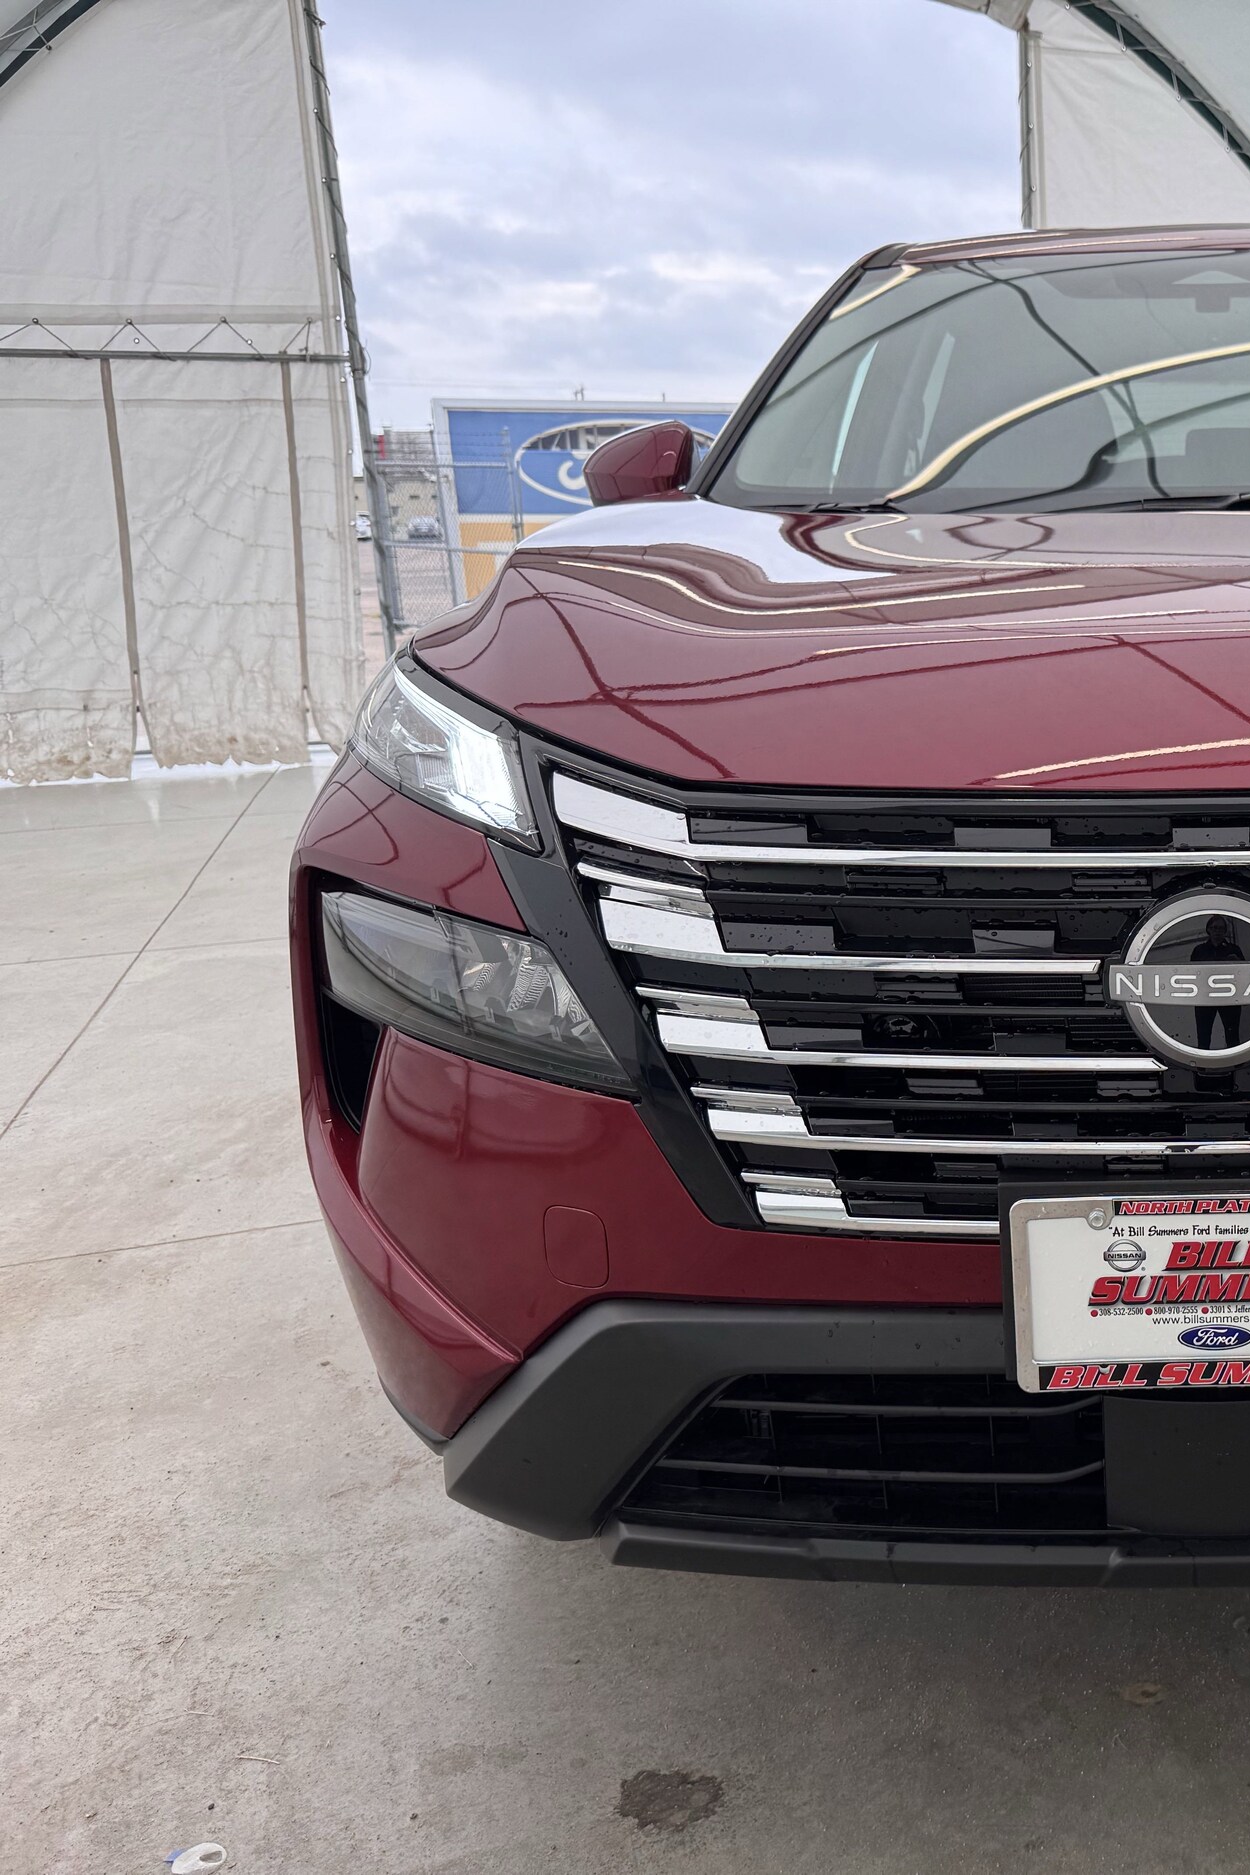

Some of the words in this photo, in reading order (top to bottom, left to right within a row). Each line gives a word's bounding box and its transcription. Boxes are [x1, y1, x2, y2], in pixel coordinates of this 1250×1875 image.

[1118, 1200, 1193, 1215] NORTH
[1128, 1225, 1145, 1237] Bill
[1147, 1225, 1189, 1237] Summers
[1192, 1224, 1211, 1236] Ford
[1214, 1224, 1249, 1236] families
[1107, 1252, 1143, 1260] NISSAN
[1098, 1307, 1144, 1317] 308-532-2500
[1153, 1306, 1199, 1315] 800-970-2555
[1209, 1305, 1226, 1314] 3301
[1227, 1304, 1234, 1314] S.
[1193, 1327, 1240, 1346] Ford
[1047, 1363, 1149, 1389] BILL
